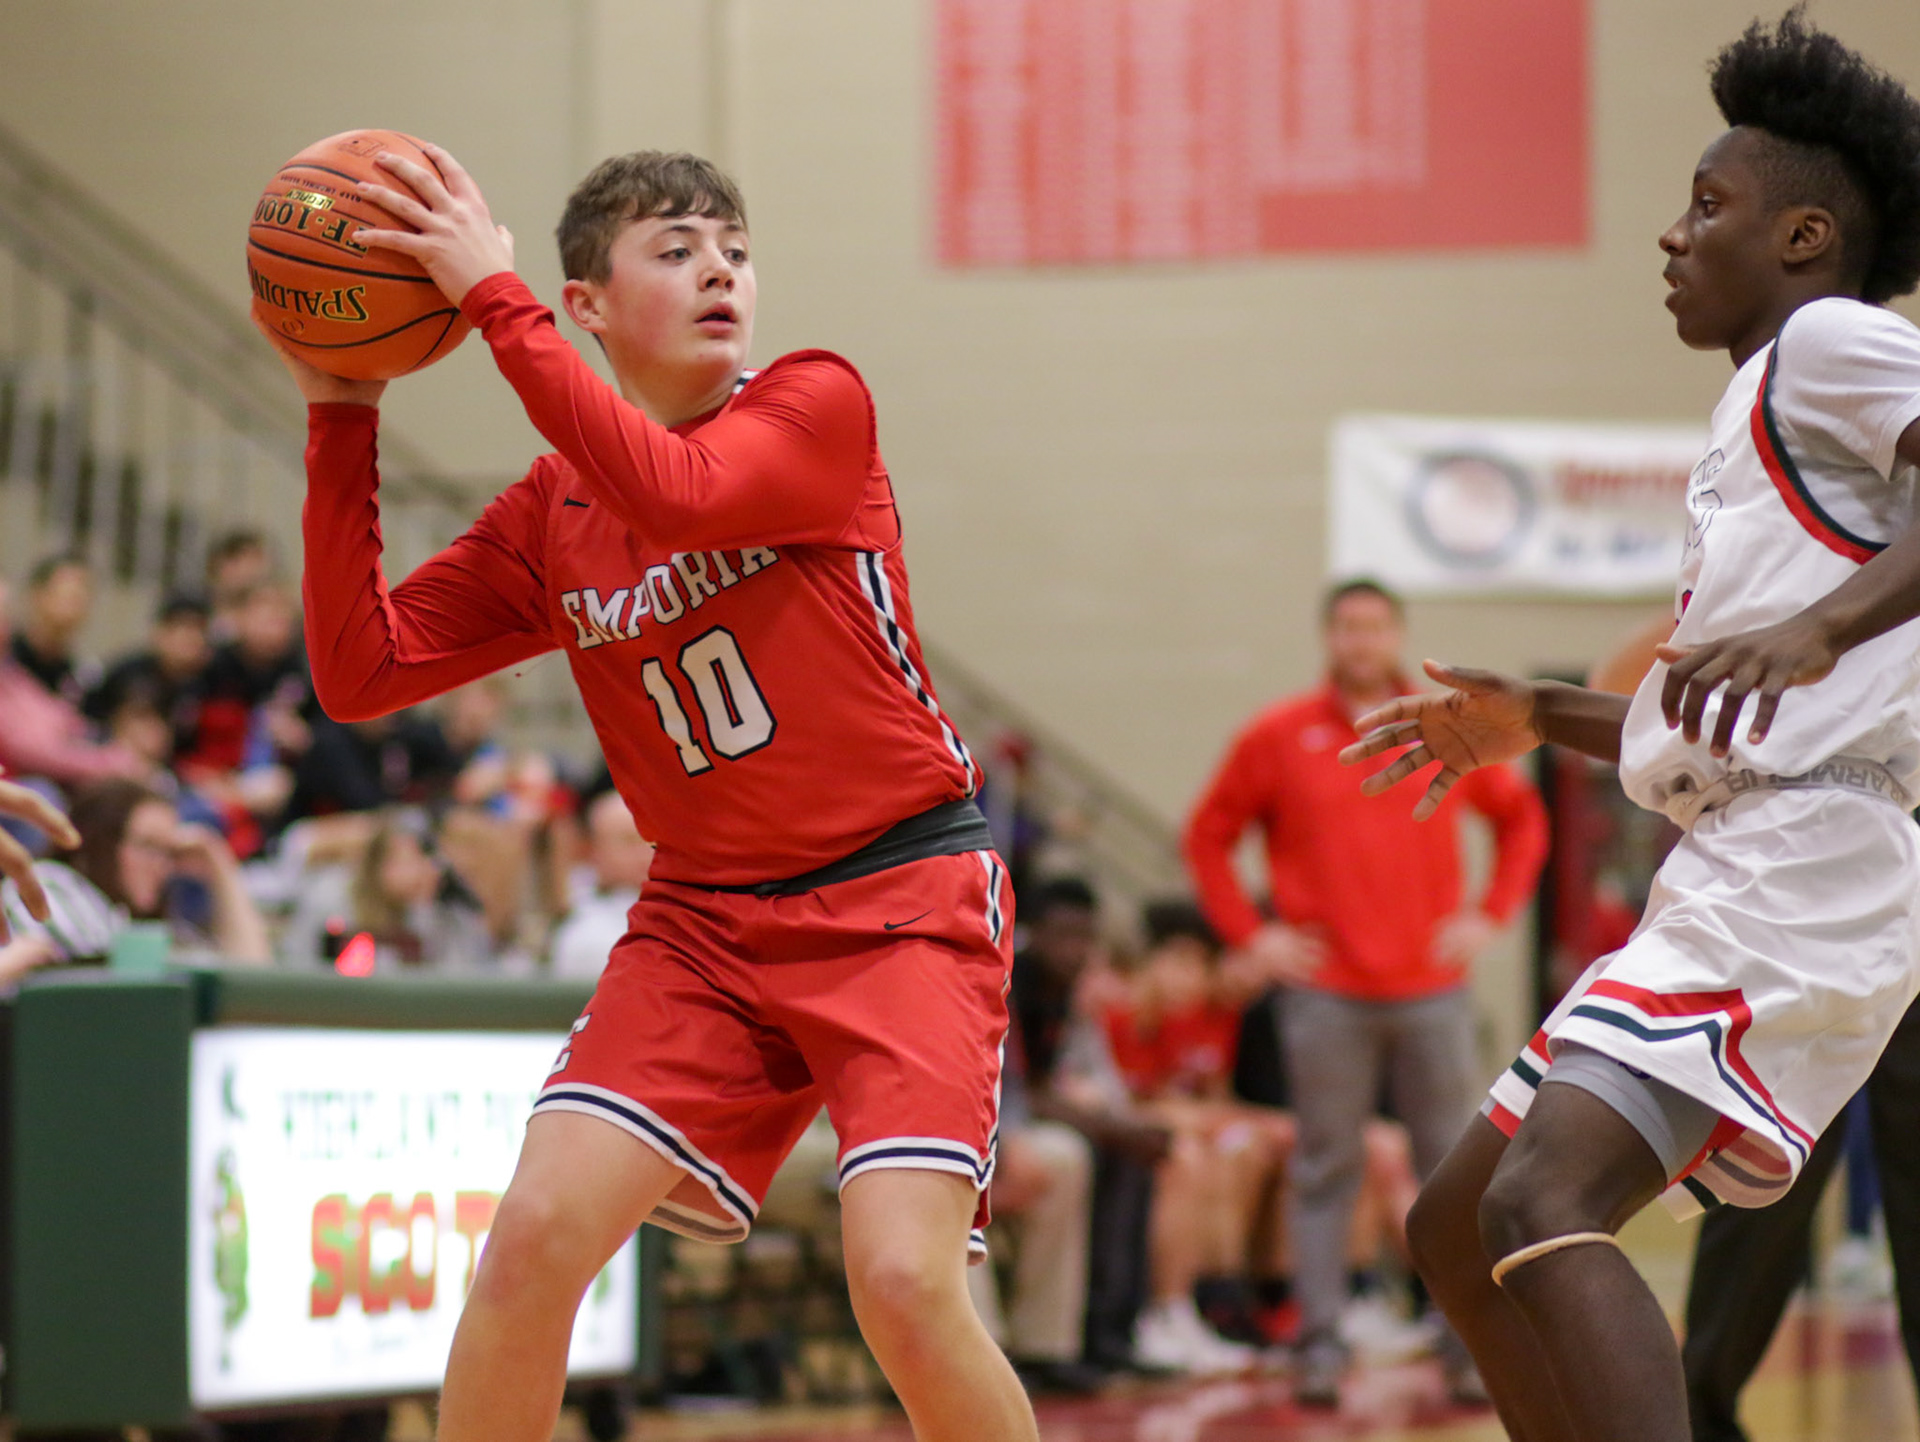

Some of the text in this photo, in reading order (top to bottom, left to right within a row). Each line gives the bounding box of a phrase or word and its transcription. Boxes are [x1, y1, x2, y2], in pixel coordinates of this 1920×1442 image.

[286, 190, 334, 209] LEGACY
[251, 269, 369, 323] SPALDIN
[561, 546, 780, 650] EMPORIA
[640, 624, 778, 778] 10
